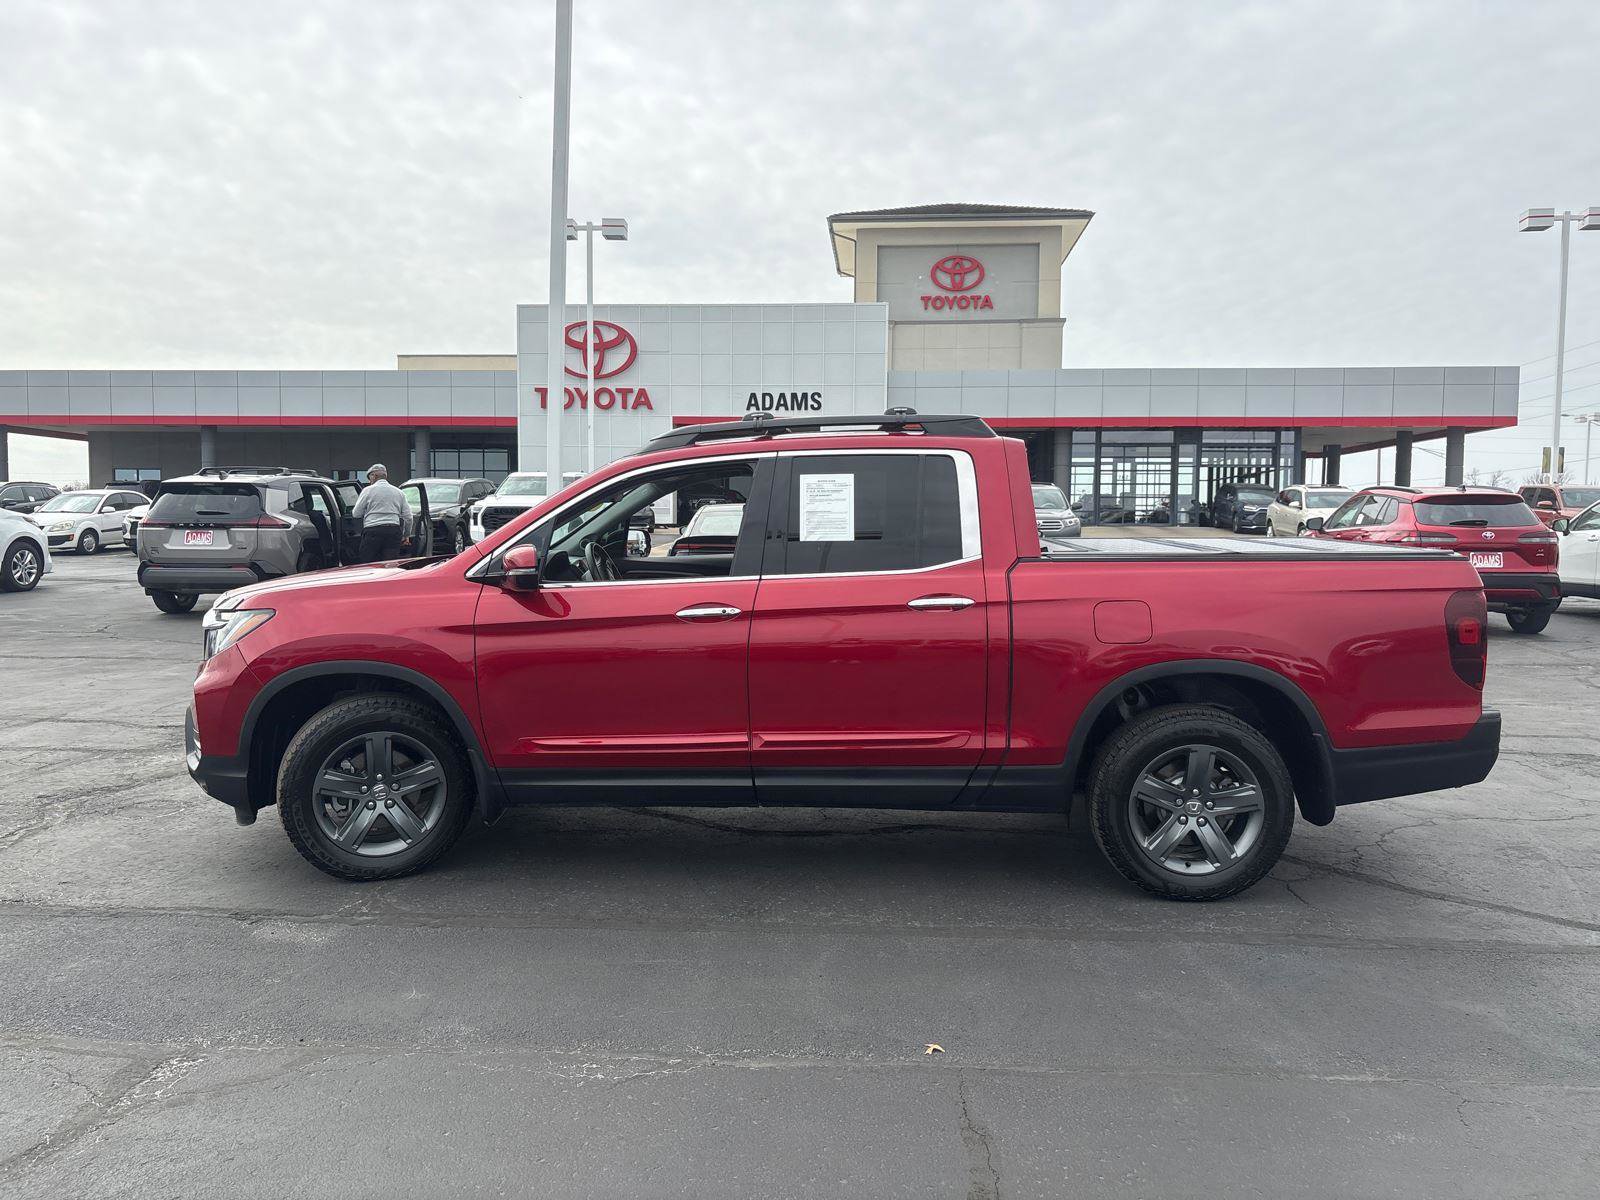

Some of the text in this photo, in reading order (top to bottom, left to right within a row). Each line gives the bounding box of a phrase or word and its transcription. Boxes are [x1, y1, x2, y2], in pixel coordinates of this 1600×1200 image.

[920, 295, 994, 310] TOYOTA
[746, 392, 822, 411] ADAMS
[186, 532, 211, 543] ADAMS
[1472, 555, 1500, 567] ADAMS
